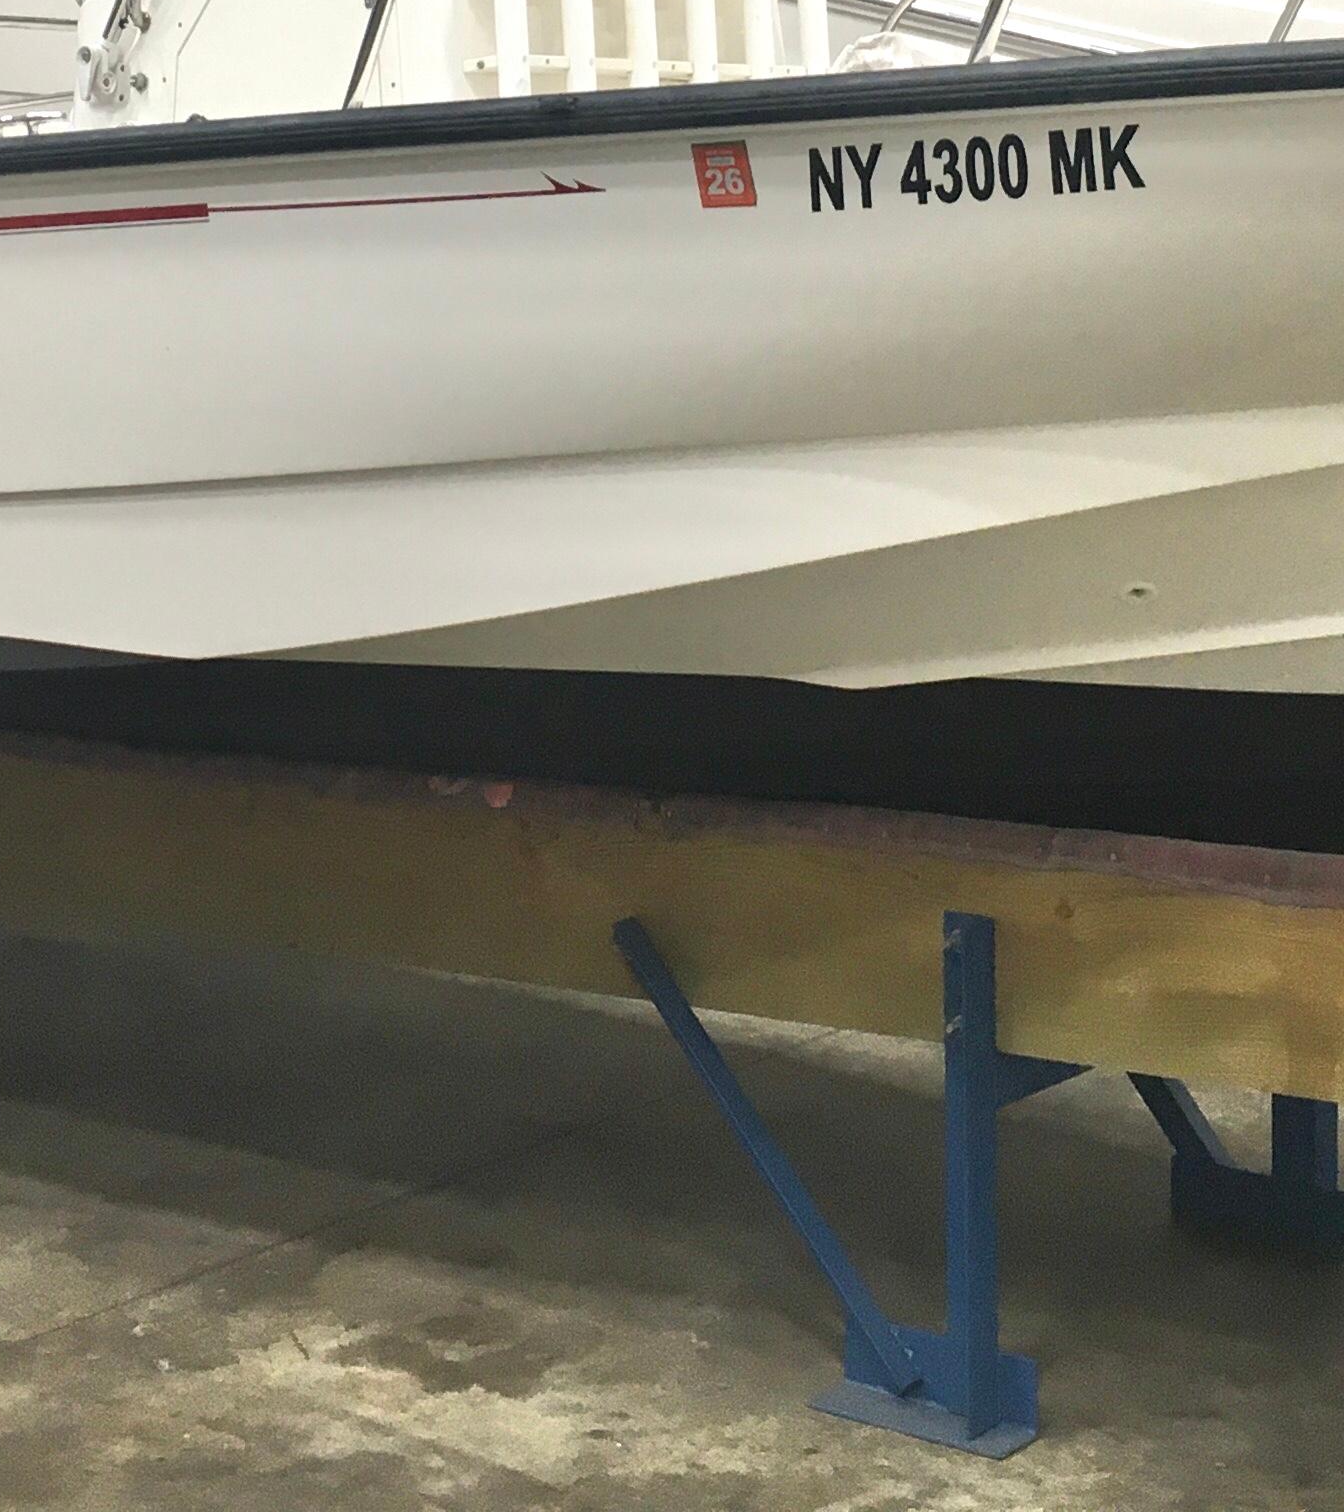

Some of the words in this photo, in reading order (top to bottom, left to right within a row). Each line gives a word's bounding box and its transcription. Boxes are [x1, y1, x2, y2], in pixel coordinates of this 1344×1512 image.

[704, 167, 745, 195] 26
[808, 143, 882, 212] NY
[900, 134, 1028, 204] 4300
[1048, 124, 1146, 194] MK
